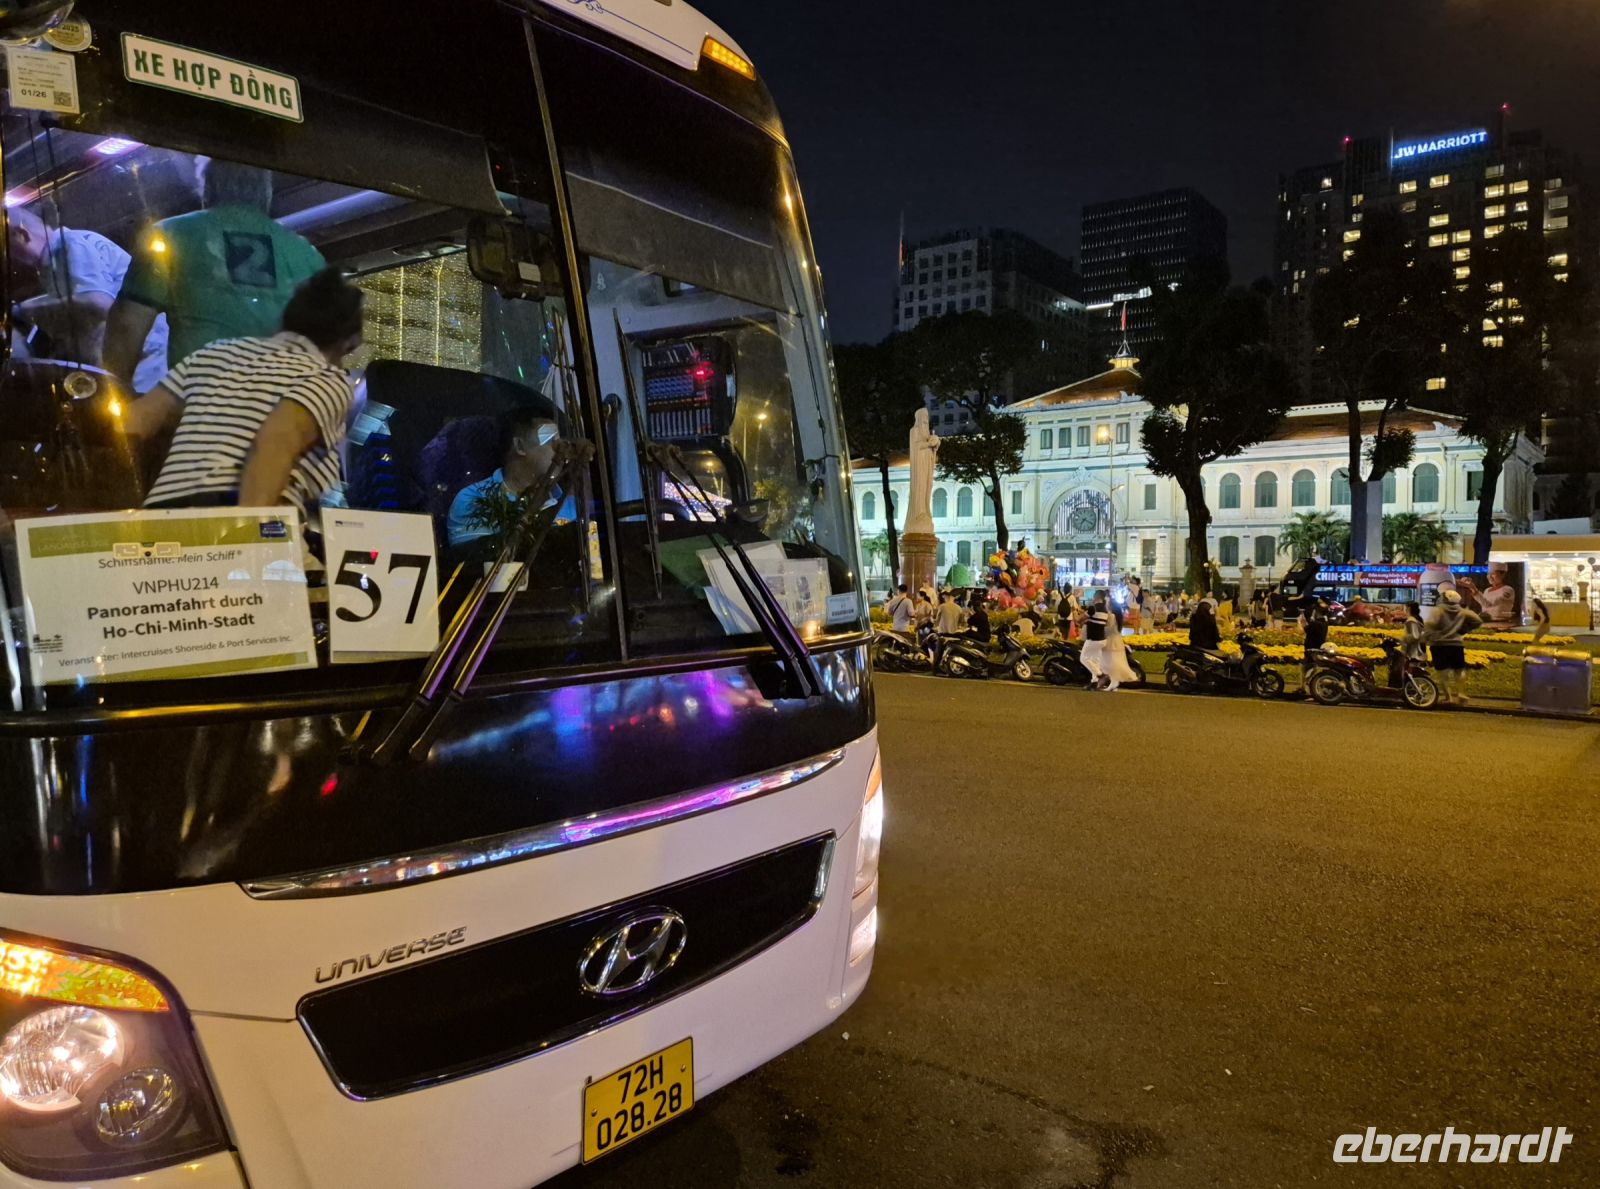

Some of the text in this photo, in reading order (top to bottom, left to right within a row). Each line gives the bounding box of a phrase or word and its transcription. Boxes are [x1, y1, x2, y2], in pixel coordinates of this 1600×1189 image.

[21, 88, 47, 99] 01/26
[133, 48, 293, 110] XE HỢP ĐỒNG
[1393, 131, 1488, 159] JW MARRIOTT
[178, 553, 203, 564] Mein
[131, 576, 220, 595] VNPHU214
[334, 549, 432, 624] 57
[87, 593, 263, 620] Panoramafahrt durch
[103, 613, 255, 639] Ho-Chi-Minh-Stadt
[58, 654, 119, 667] Veranstter:
[121, 647, 173, 660] Intercruises
[175, 641, 217, 654] Shoreside
[226, 638, 244, 648] Port
[246, 636, 277, 646] Services
[315, 926, 467, 984] UNIVERSE
[617, 1055, 664, 1104] 72H
[597, 1082, 682, 1151] 028.28
